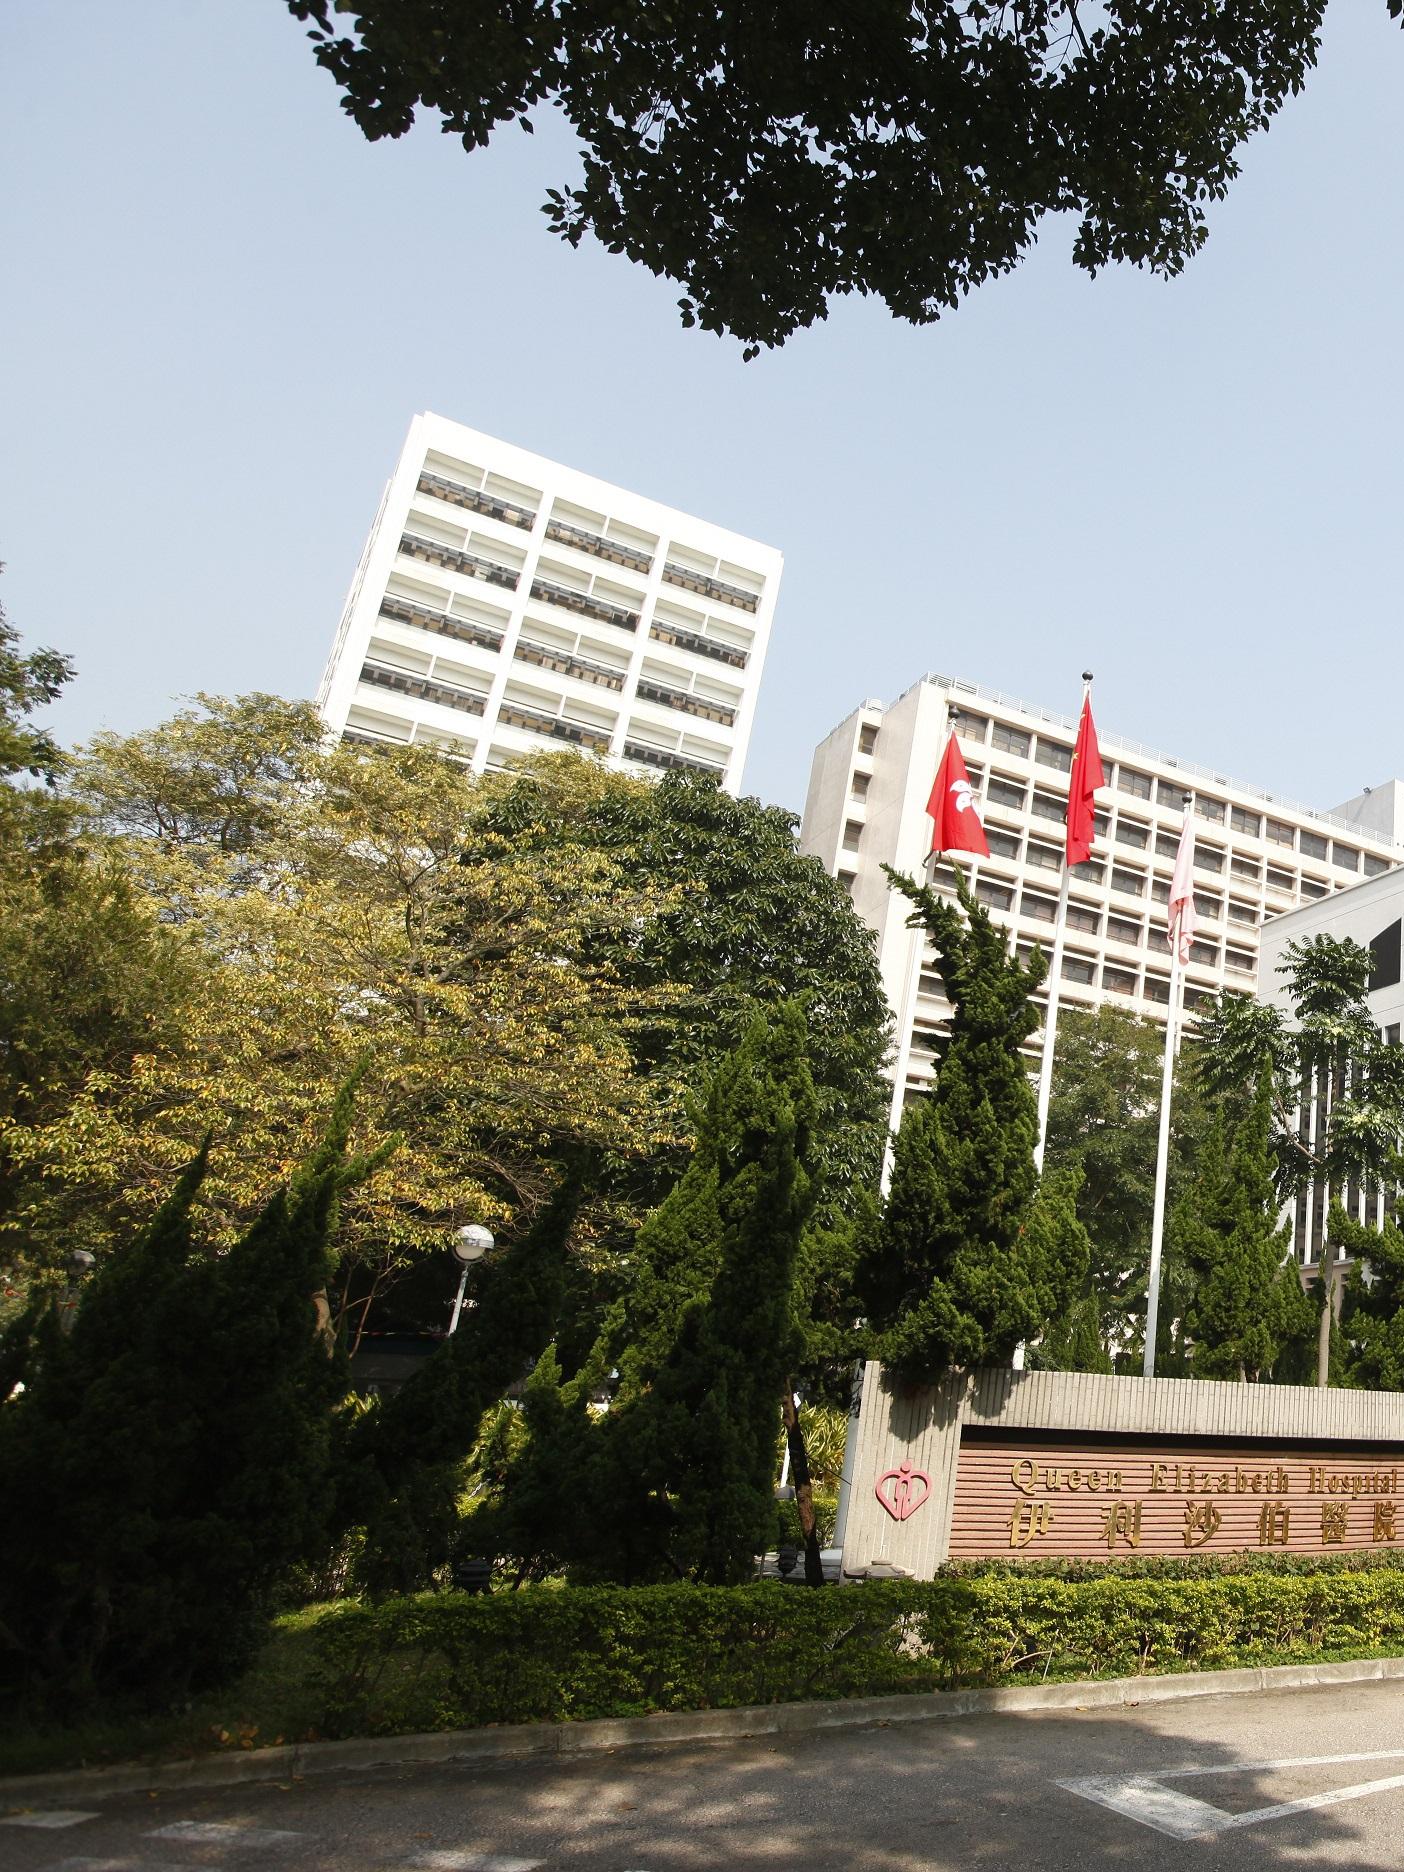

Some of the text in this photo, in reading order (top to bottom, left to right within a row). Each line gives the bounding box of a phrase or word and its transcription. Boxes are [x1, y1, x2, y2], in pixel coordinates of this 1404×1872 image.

[1011, 1459, 1398, 1500] Queen Elizabeth Hospital
[1007, 1498, 1397, 1549] 伊利沙伯醫院
